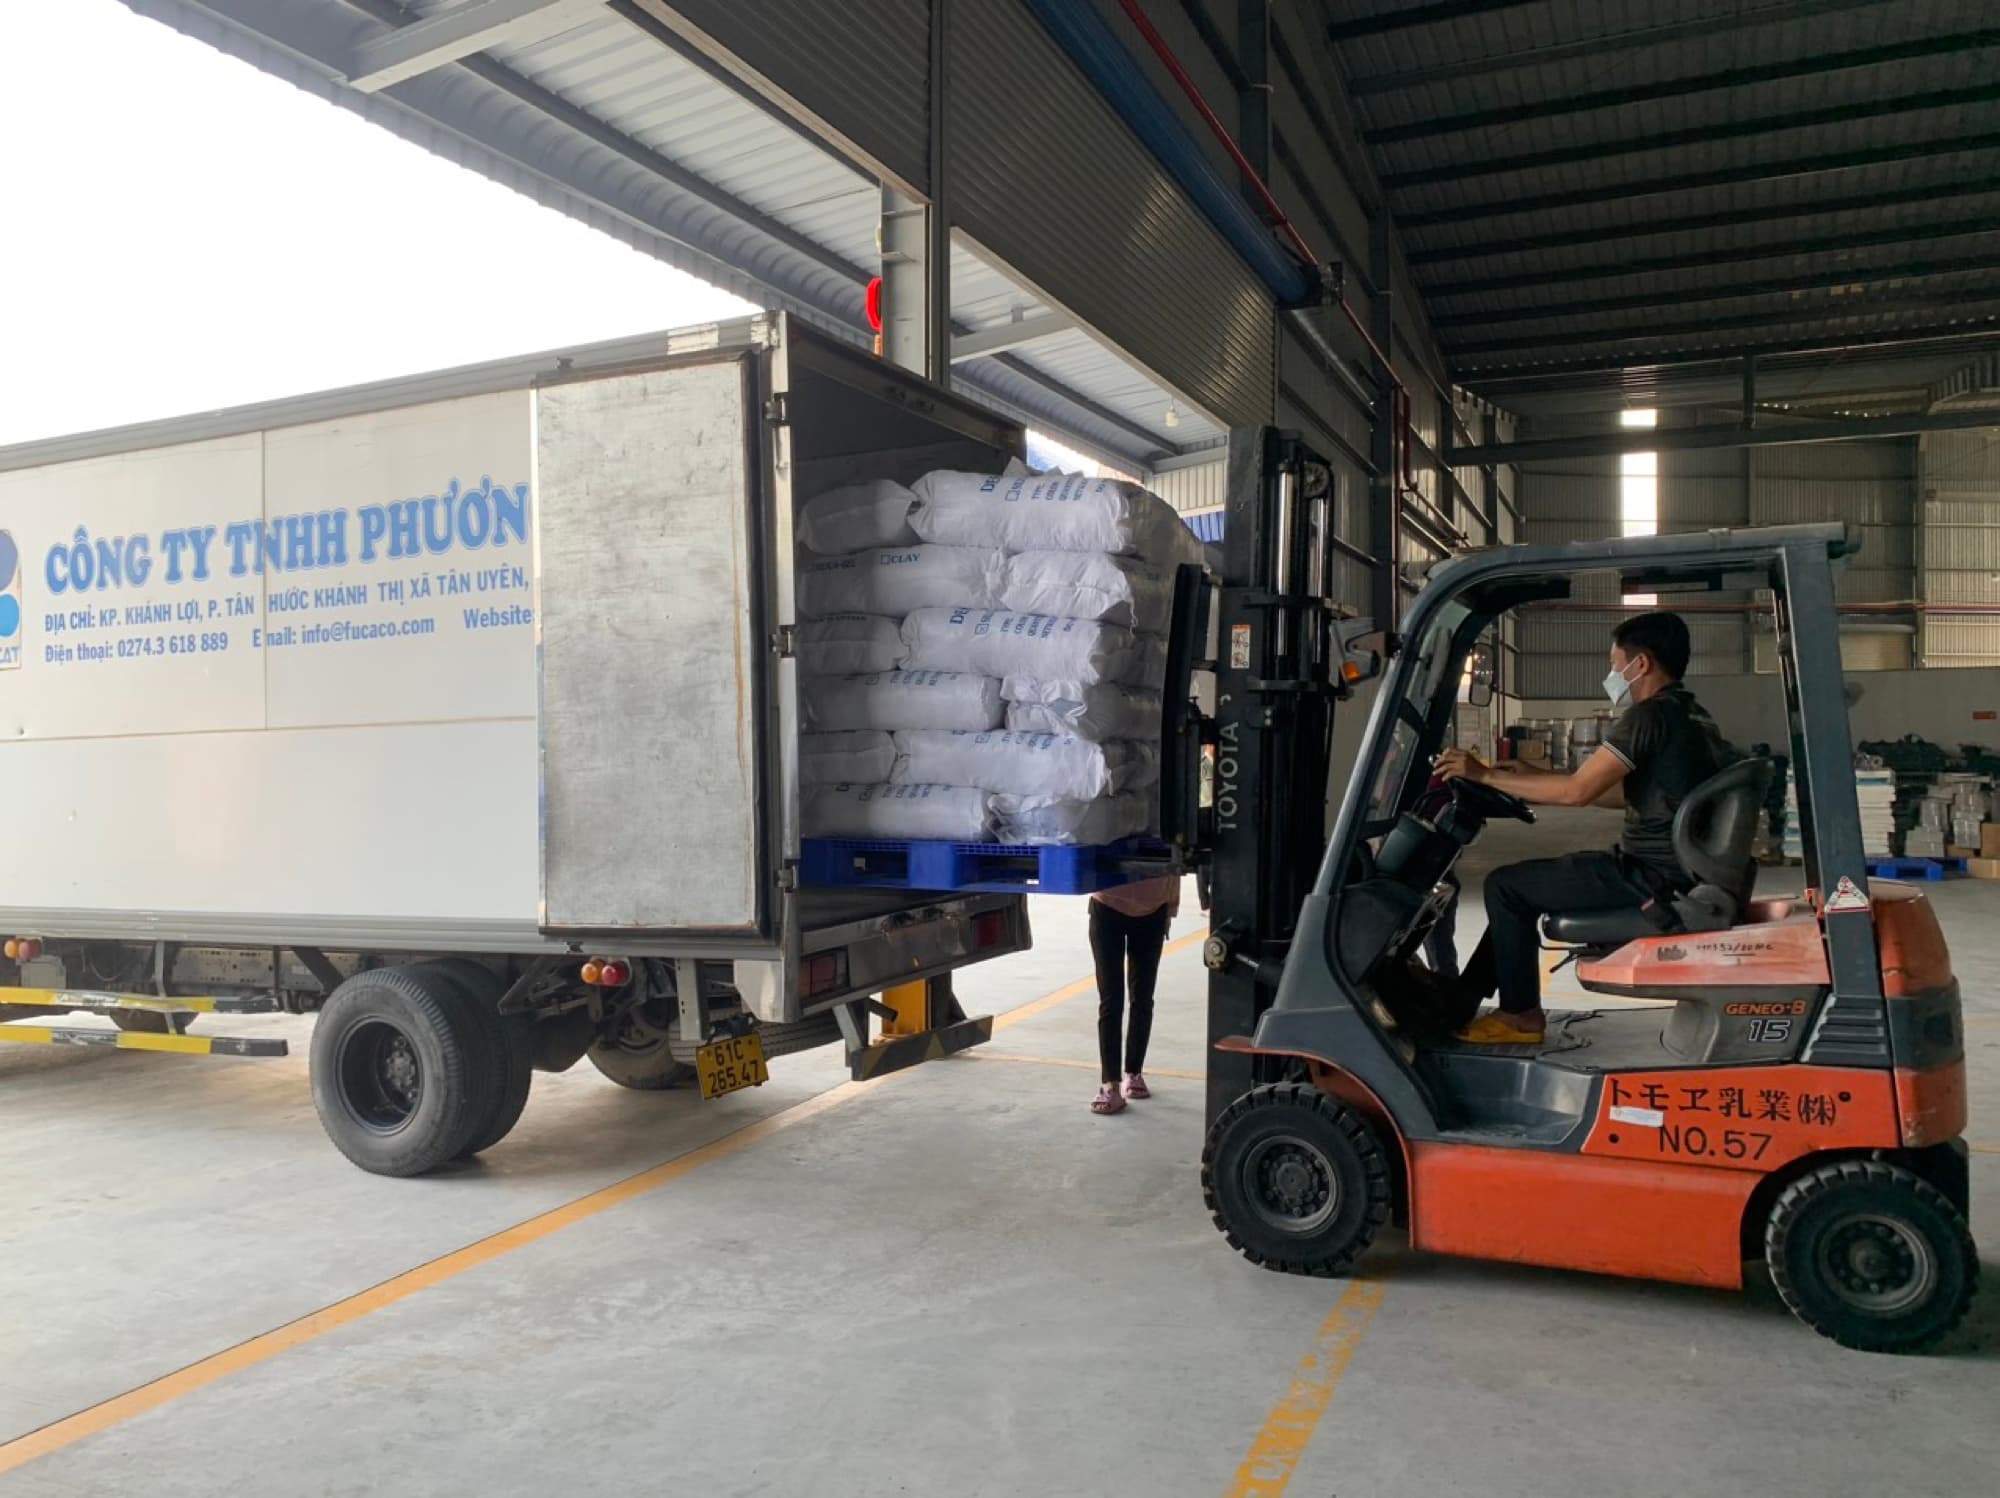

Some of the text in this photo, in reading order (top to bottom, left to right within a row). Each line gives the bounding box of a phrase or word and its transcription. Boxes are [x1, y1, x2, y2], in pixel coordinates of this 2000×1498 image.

[46, 524, 152, 594] CÔNG
[160, 525, 217, 584] TY
[225, 508, 349, 576] TNHH
[45, 613, 66, 635] ĐỊA
[70, 604, 95, 630] CHỈ:
[99, 608, 121, 627] KP.
[208, 600, 221, 618] P.
[225, 592, 254, 616] TÂN
[314, 582, 367, 608] KHÁNH
[378, 579, 404, 605] THỊ
[410, 572, 431, 599] XÃ
[436, 569, 471, 595] TÂN
[477, 562, 529, 592] UYÊN,
[45, 644, 73, 665] Điện
[77, 641, 113, 663] thoại:
[117, 636, 165, 657] 0274.3
[169, 634, 196, 653] 618
[201, 632, 228, 651] 889
[301, 618, 434, 644] info@fucaco.com
[1217, 720, 1239, 834] TOYOTA
[1748, 1018, 1791, 1042] 15
[714, 1039, 744, 1067] 61C
[707, 1059, 760, 1094] 265.47
[1659, 1124, 1773, 1161] NO.57
